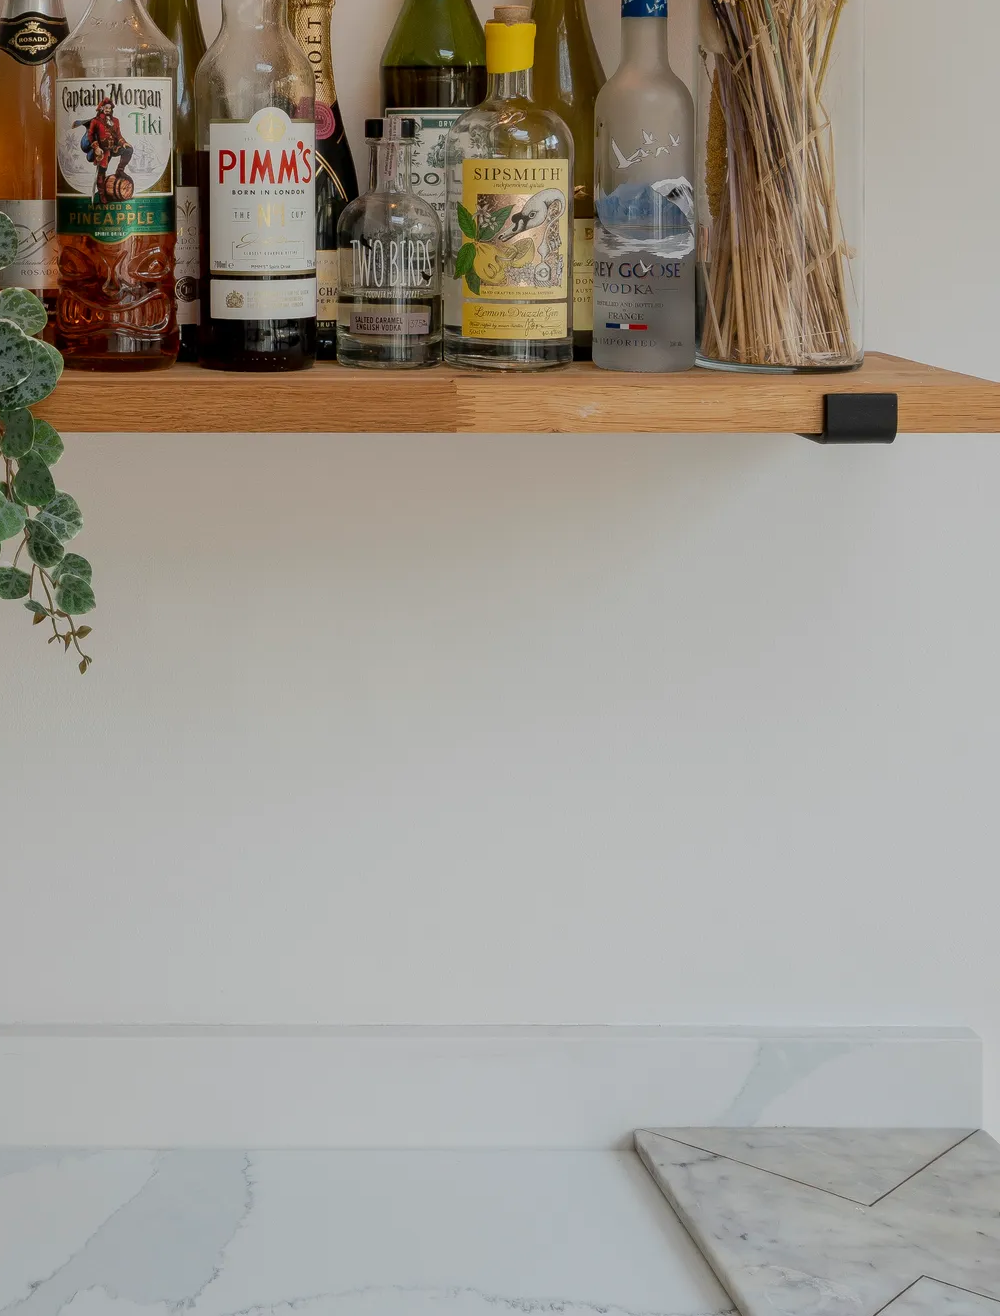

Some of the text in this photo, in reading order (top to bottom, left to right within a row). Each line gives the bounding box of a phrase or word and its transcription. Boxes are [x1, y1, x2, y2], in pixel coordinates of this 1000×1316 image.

[18, 36, 48, 44] ROSADO
[61, 83, 162, 113] Captain Morgan
[127, 112, 162, 136] Tiki
[438, 120, 453, 128] DRY
[218, 140, 313, 185] PIMM'S
[473, 167, 562, 182] SIPSMITH
[125, 203, 133, 211] &
[69, 211, 155, 225] PINEAPPLE
[233, 211, 251, 220] THE
[291, 210, 304, 219] CUP
[349, 237, 434, 288] TWO BIRDS
[19, 268, 59, 277] ROSADO
[594, 261, 614, 278] REY
[618, 262, 681, 278] GOOSE
[318, 287, 338, 297] CHA
[601, 282, 655, 295] VODKA
[473, 305, 506, 318] Lemon
[507, 306, 544, 318] Drizzle
[608, 311, 645, 321] FRANCE
[354, 315, 403, 325] SALTED CARAMEL
[355, 323, 402, 332] ENGLISH VODKA
[601, 337, 656, 348] IMPORTED
